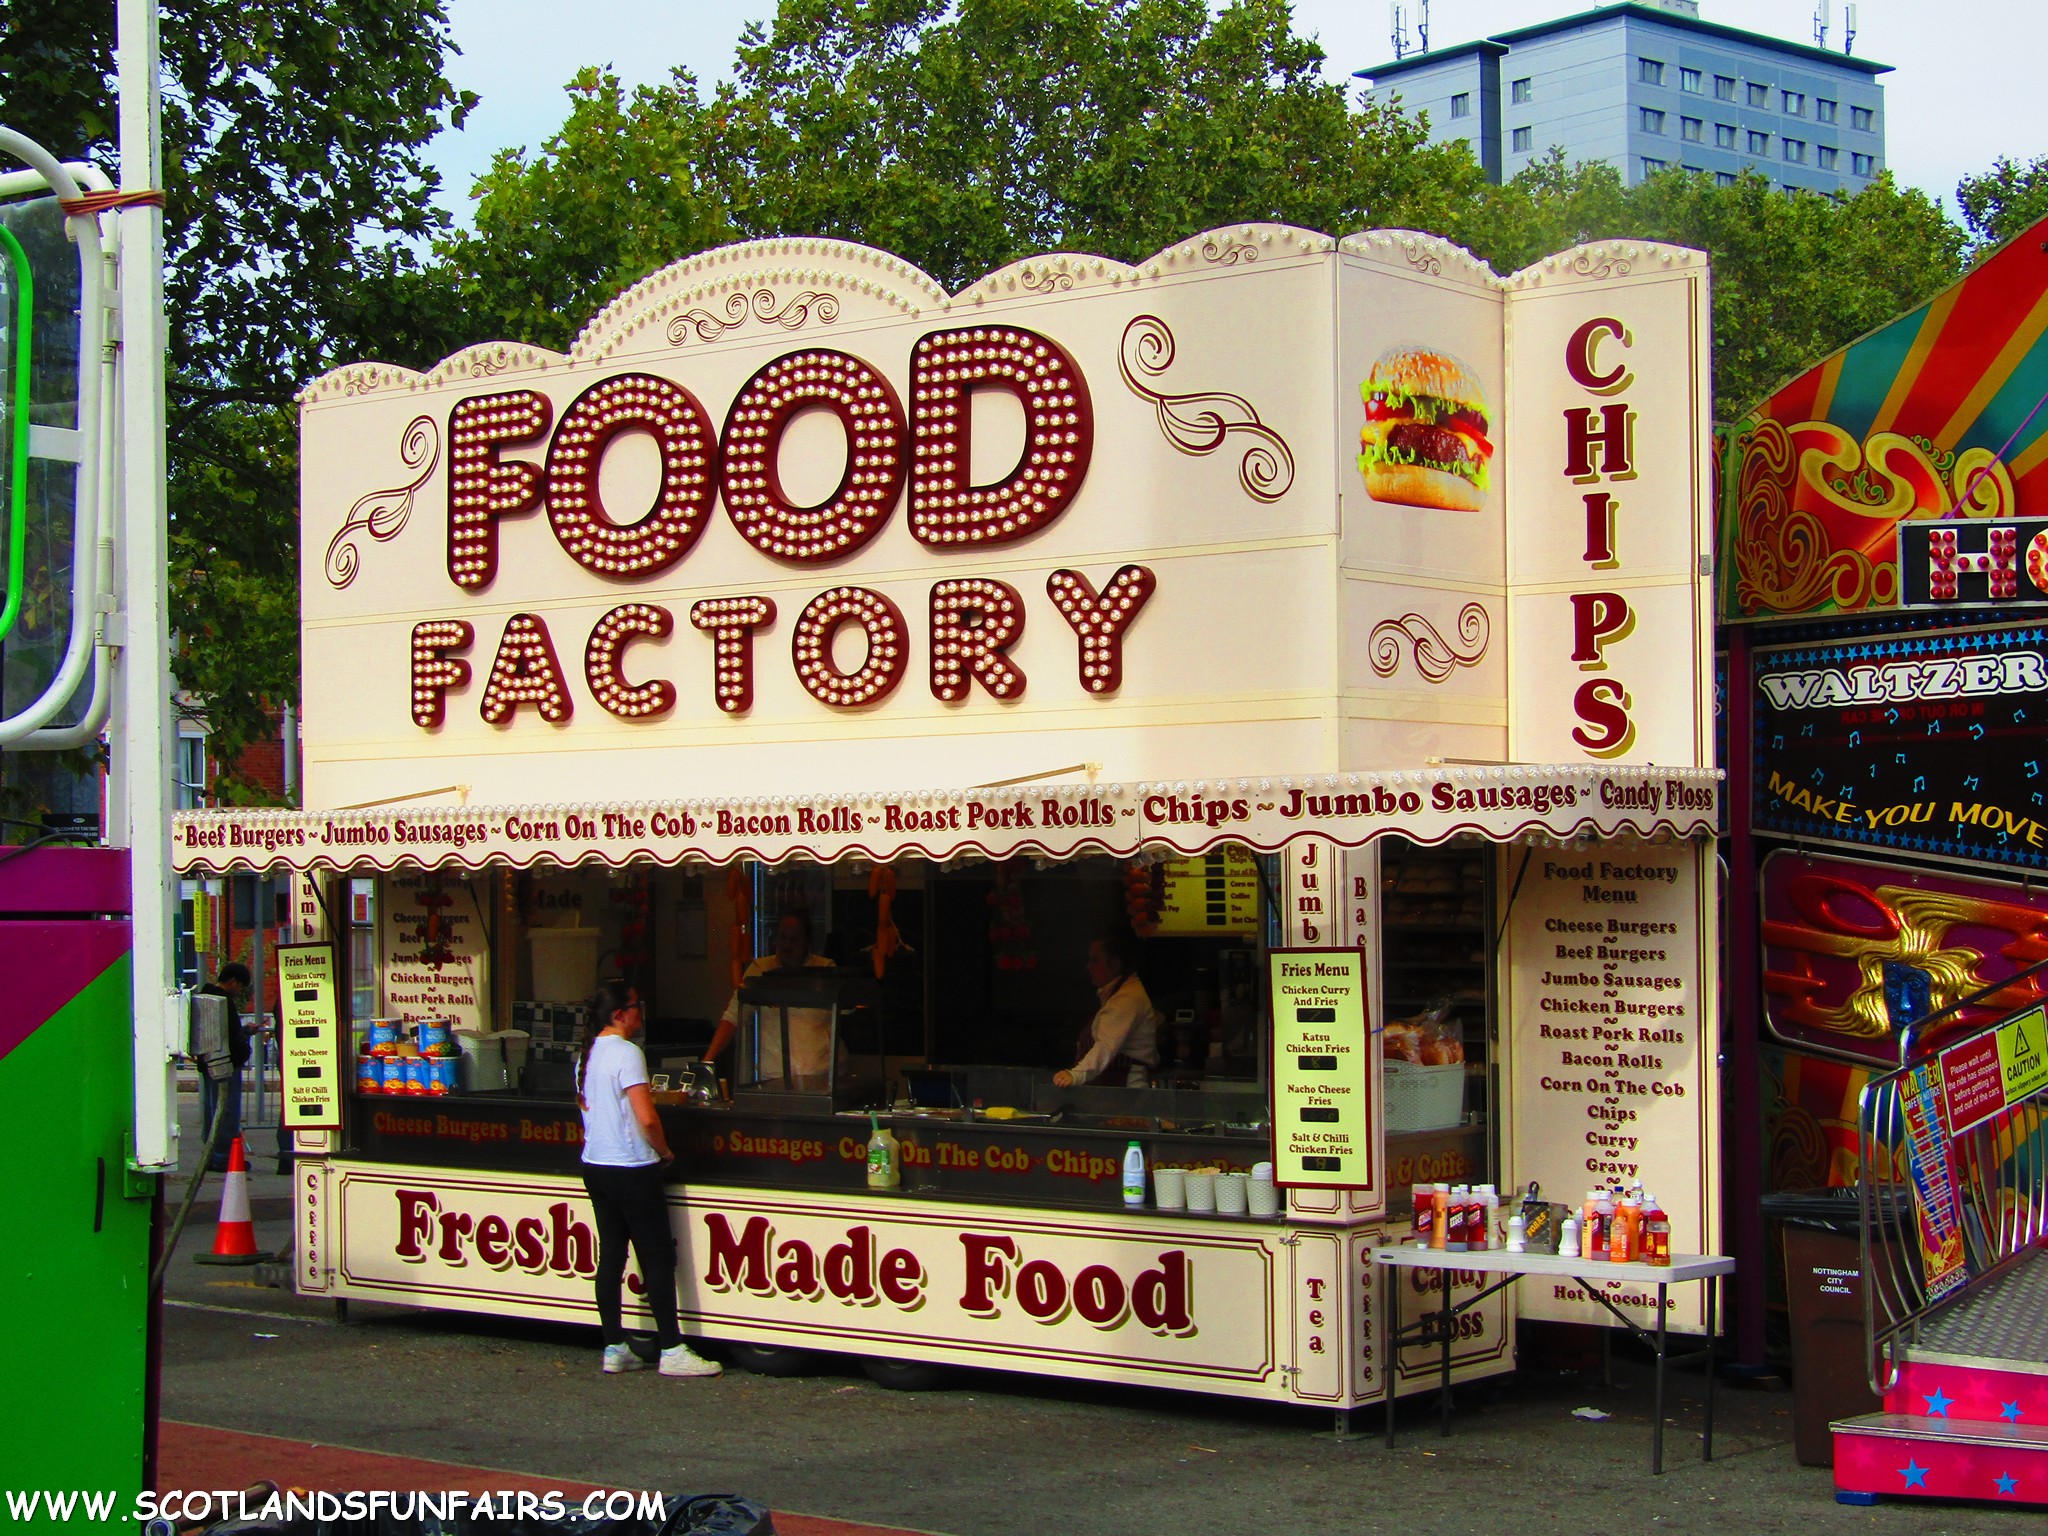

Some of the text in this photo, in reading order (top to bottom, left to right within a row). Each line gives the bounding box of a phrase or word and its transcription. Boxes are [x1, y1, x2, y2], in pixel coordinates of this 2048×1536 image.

[447, 324, 1095, 590] FOOD
[1563, 316, 1637, 759] CHIPS
[1929, 527, 2048, 601] H
[410, 563, 1157, 732] FACTORY
[1759, 651, 2048, 710] WALTZER
[1143, 781, 1577, 828] Chips Jumbo Sausages
[1600, 778, 1713, 815] Candy Floss
[1768, 770, 2048, 848] MAKE YOU MOVE
[185, 798, 1115, 851] Beef Burgers Jumbo Sausages Corn On The Cob Bacon Rolls Roast Pork Rolls
[1543, 862, 1678, 883] Food Factory
[1582, 885, 1638, 904] Menu
[301, 873, 316, 938] umb
[1545, 918, 1677, 936] Cheese Burgers
[285, 955, 326, 967] Fries Menu
[391, 953, 421, 965] Jumb
[1556, 945, 1666, 963] Beef Burgers
[285, 972, 326, 981] Chicken Curry
[1281, 962, 1350, 977] Fries Menu
[292, 981, 304, 989] And
[391, 973, 474, 987] Chicken Burgers
[1541, 971, 1682, 991] Jumbo Sausages
[390, 993, 474, 1006] Roast Pork Rolls
[1281, 985, 1350, 996] Chicken Curry
[1293, 997, 1339, 1006] And Fries
[1540, 998, 1685, 1017] Chicken Burgers
[288, 1017, 327, 1026] Chicken Fries
[435, 1013, 461, 1025] Rlls
[1302, 1033, 1330, 1042] Katsu
[1540, 1024, 1684, 1044] Roast Pork Rolls
[289, 1049, 328, 1057] Nacho Cheese
[1286, 1044, 1351, 1054] Chicken Fries
[302, 1058, 317, 1066] Fries
[1562, 1051, 1663, 1070] Bacon Rolls
[1950, 1049, 1991, 1076] Please wait until
[2007, 1053, 2040, 1081] CAUTION
[1947, 1059, 1998, 1091] the ride has stopped
[1287, 1084, 1351, 1094] Nacho Cheese
[1540, 1076, 1685, 1097] Corn On The Cob
[1954, 1075, 1996, 1101] before getting in
[291, 1095, 330, 1104] Chicken Fries
[1308, 1096, 1332, 1105] Fries
[1953, 1102, 1964, 1115] and
[1964, 1096, 1974, 1109] out
[1974, 1094, 1980, 1104] of
[1979, 1091, 1988, 1102] the
[1989, 1086, 1999, 1098] cars
[1587, 1105, 1637, 1122] Chips
[373, 1111, 433, 1136] Cheese
[436, 1113, 508, 1141] Burgers
[520, 1119, 561, 1143] Beef
[1292, 1133, 1349, 1143] Salt & Chilli
[1585, 1132, 1639, 1150] Curry
[729, 1131, 824, 1162] Sausages
[839, 1136, 869, 1161] Co
[902, 1140, 932, 1165] On
[936, 1142, 979, 1168] The
[984, 1145, 1030, 1171] Cob
[1046, 1149, 1116, 1181] Chips
[1289, 1144, 1353, 1155] Chicken Fries
[1585, 1158, 1639, 1177] Gravy
[395, 1189, 1199, 1339] Fresh Made Food
[1812, 1267, 1859, 1278] NOTTINGHAM
[1819, 1284, 1852, 1295] COUNCIL
[1826, 1276, 1844, 1286] CITY
[1553, 1285, 1677, 1310] Hot Chocolae
